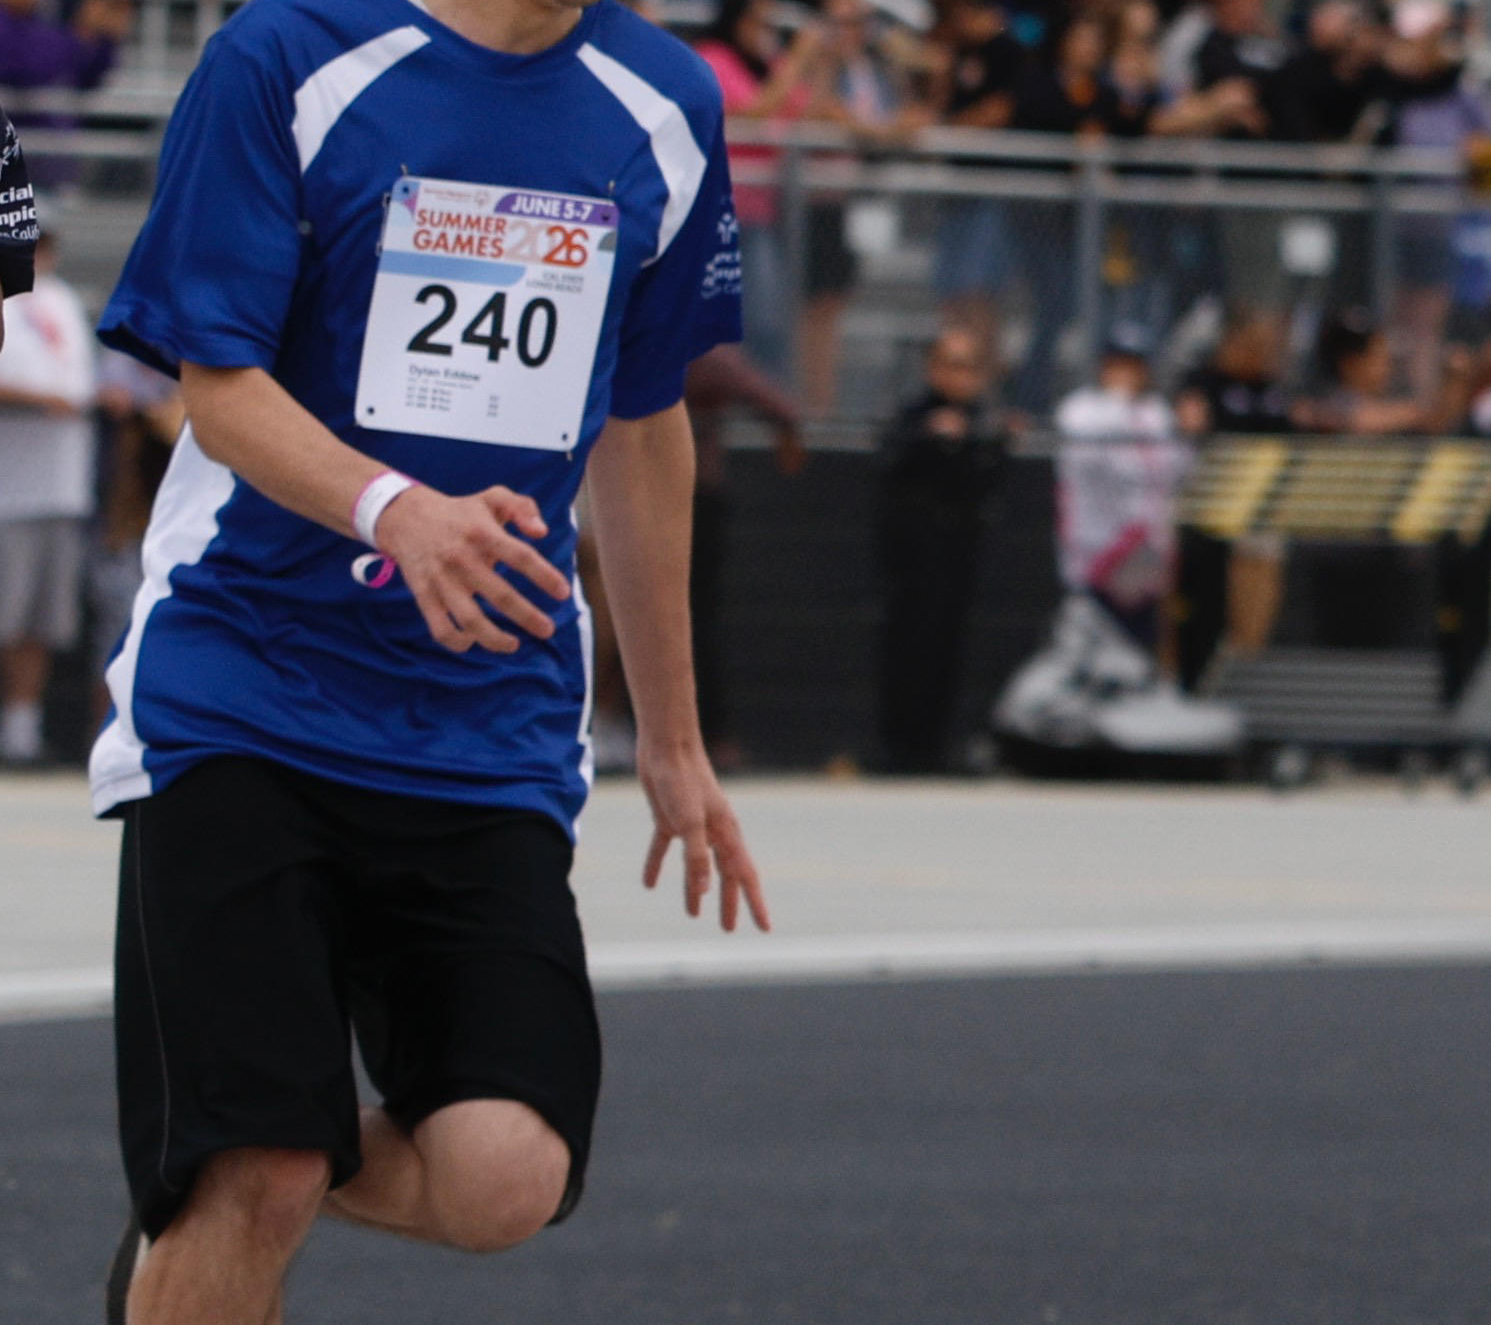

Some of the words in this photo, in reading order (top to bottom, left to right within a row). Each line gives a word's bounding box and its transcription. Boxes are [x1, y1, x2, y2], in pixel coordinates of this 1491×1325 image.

[416, 208, 507, 235] SUMMER
[511, 195, 561, 218] JUNE
[562, 201, 593, 222] 5-7
[413, 229, 504, 259] GAMES
[406, 284, 558, 369] 240
